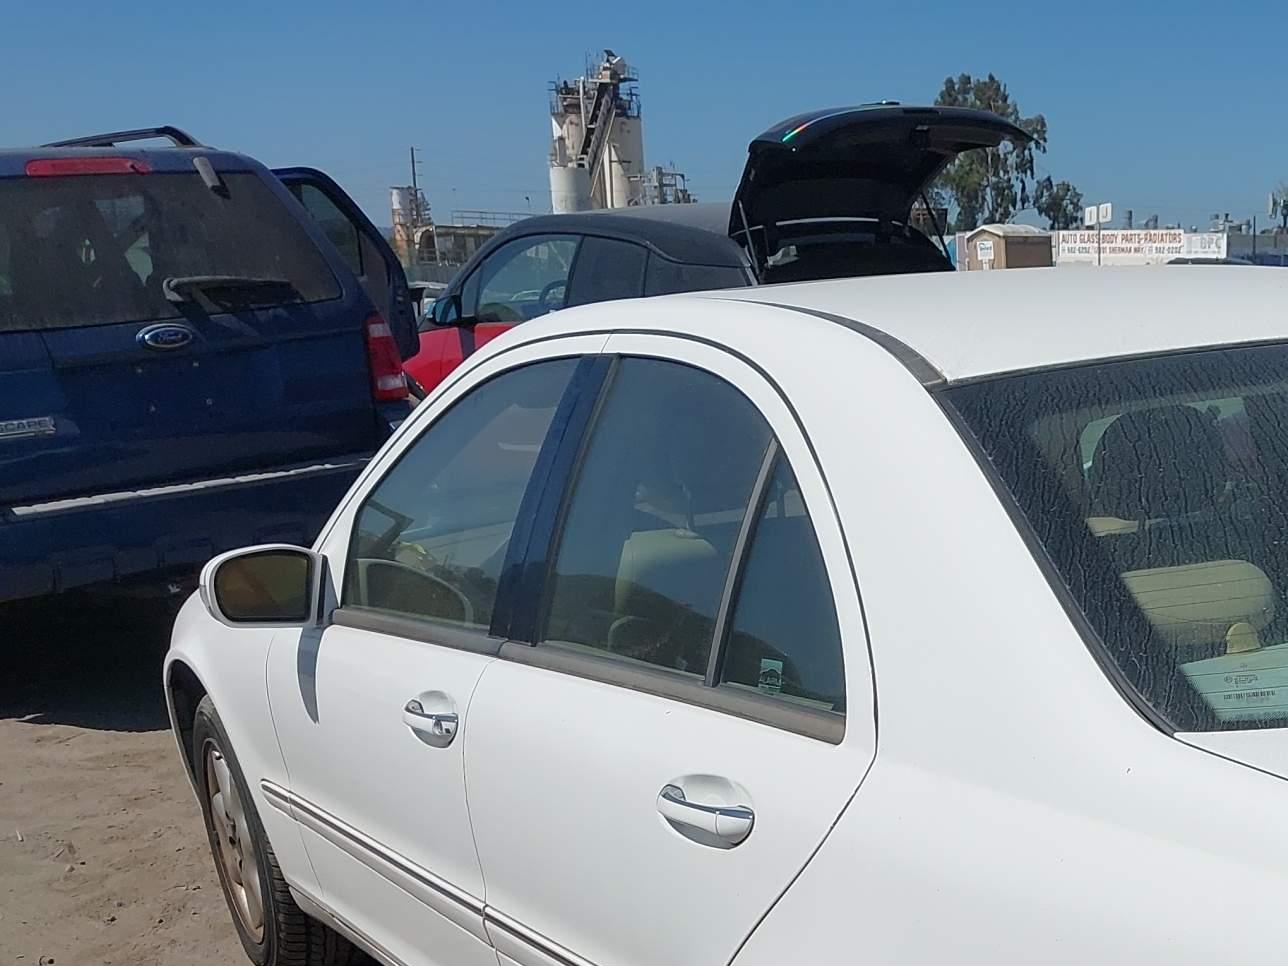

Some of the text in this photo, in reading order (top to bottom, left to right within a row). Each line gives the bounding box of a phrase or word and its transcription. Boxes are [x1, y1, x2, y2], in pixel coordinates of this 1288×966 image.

[1061, 233, 1078, 244] AUTO
[1079, 233, 1099, 244] GLASS
[1101, 233, 1118, 244] BODY
